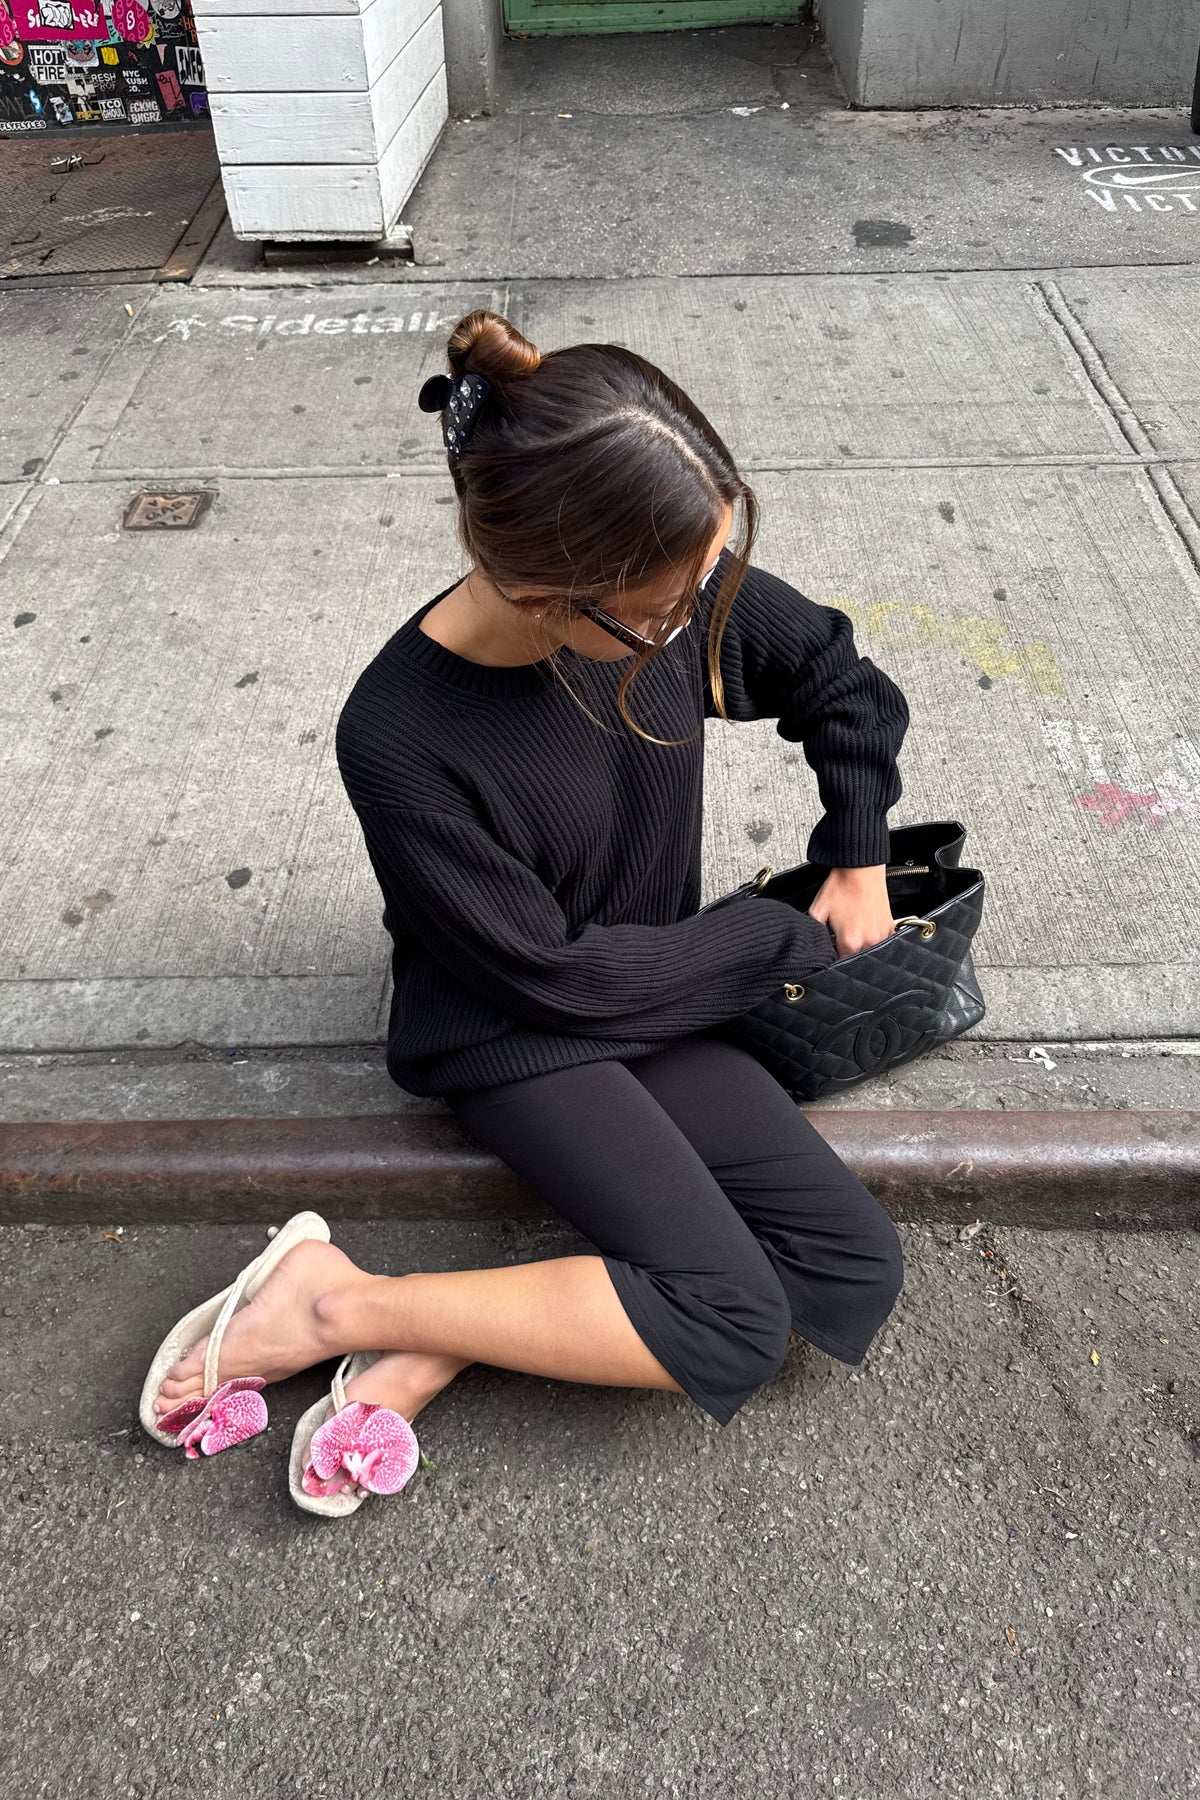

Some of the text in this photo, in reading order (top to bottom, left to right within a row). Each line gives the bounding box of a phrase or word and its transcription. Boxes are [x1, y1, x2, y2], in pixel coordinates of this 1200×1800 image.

[34, 50, 60, 64] HOT
[36, 66, 65, 80] FIRE
[1085, 189, 1199, 213] VICT
